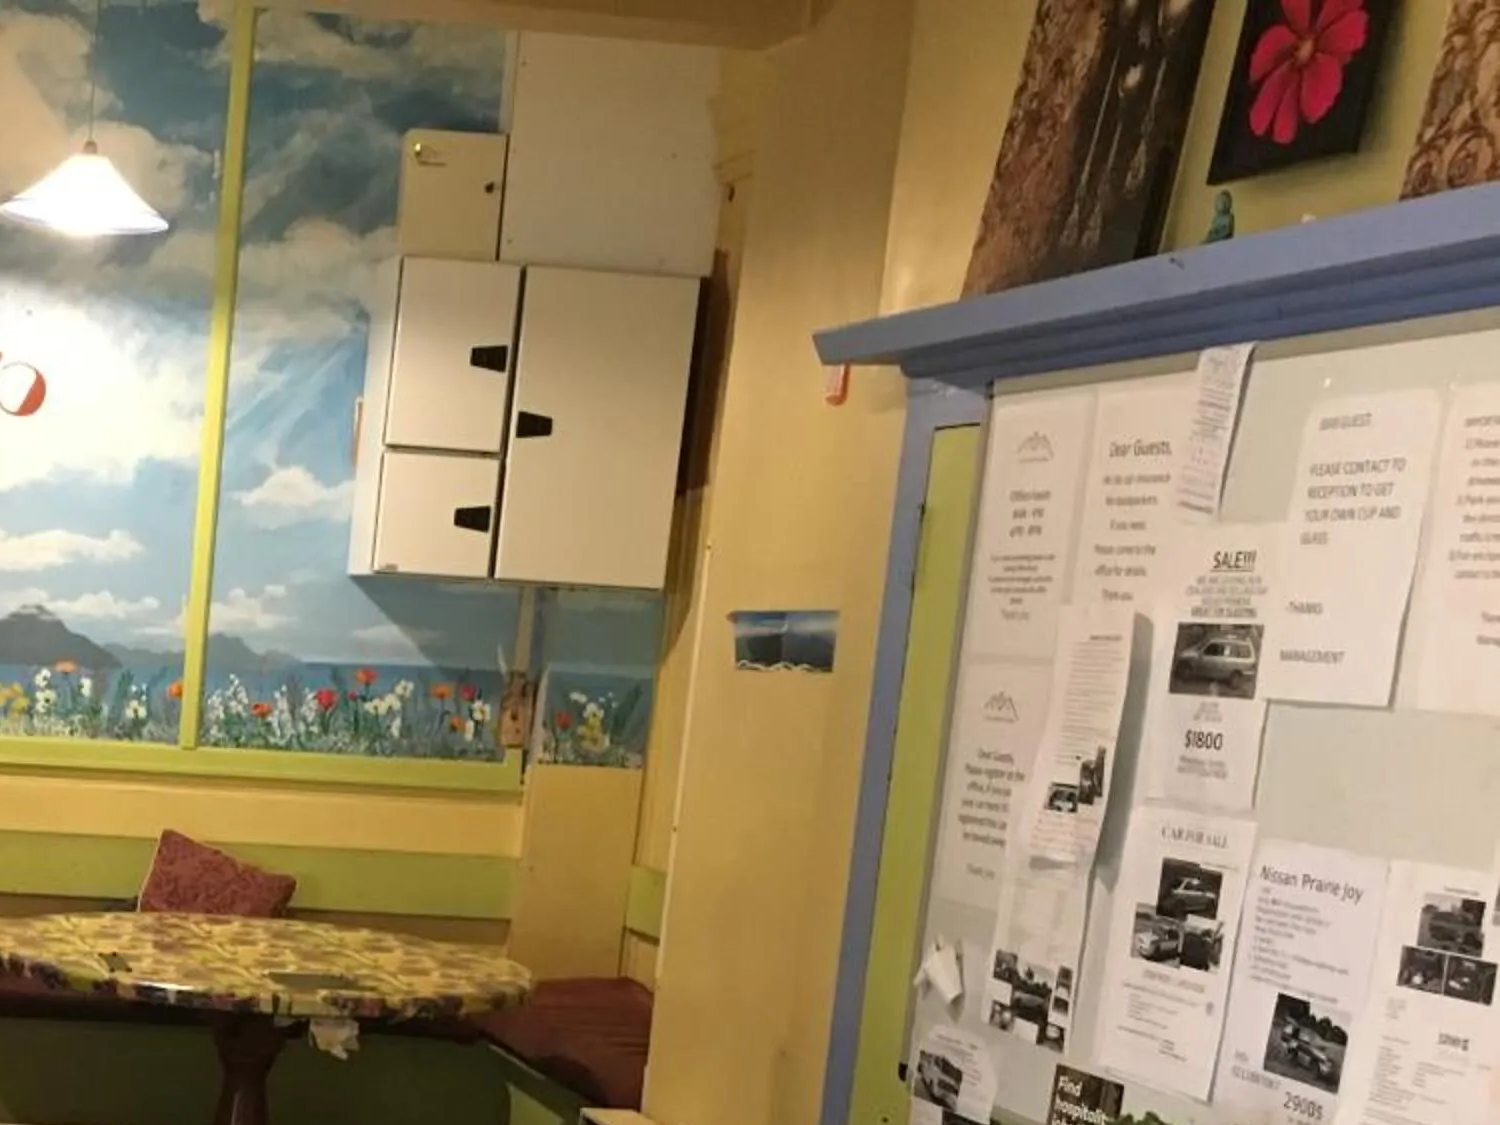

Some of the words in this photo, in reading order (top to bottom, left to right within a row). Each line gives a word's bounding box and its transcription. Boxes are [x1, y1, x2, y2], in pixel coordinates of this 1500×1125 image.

[1108, 441, 1132, 458] Dear
[1310, 462, 1341, 477] PLEASE
[1343, 459, 1390, 476] CONTACT
[1391, 457, 1407, 472] TO
[1307, 484, 1358, 500] RECEPTION
[1360, 483, 1374, 497] TO
[1375, 482, 1395, 496] GET
[1304, 507, 1330, 522] YOUR
[1330, 507, 1355, 521] OWN
[1357, 506, 1378, 521] CUP
[1378, 506, 1401, 520] AND
[1279, 649, 1345, 664] MANAGEMENT
[1184, 729, 1224, 750] $1800
[1161, 826, 1185, 842] CAR
[1260, 864, 1298, 887] Nissan
[1301, 873, 1342, 898] Prairie
[1059, 1075, 1083, 1097] Find
